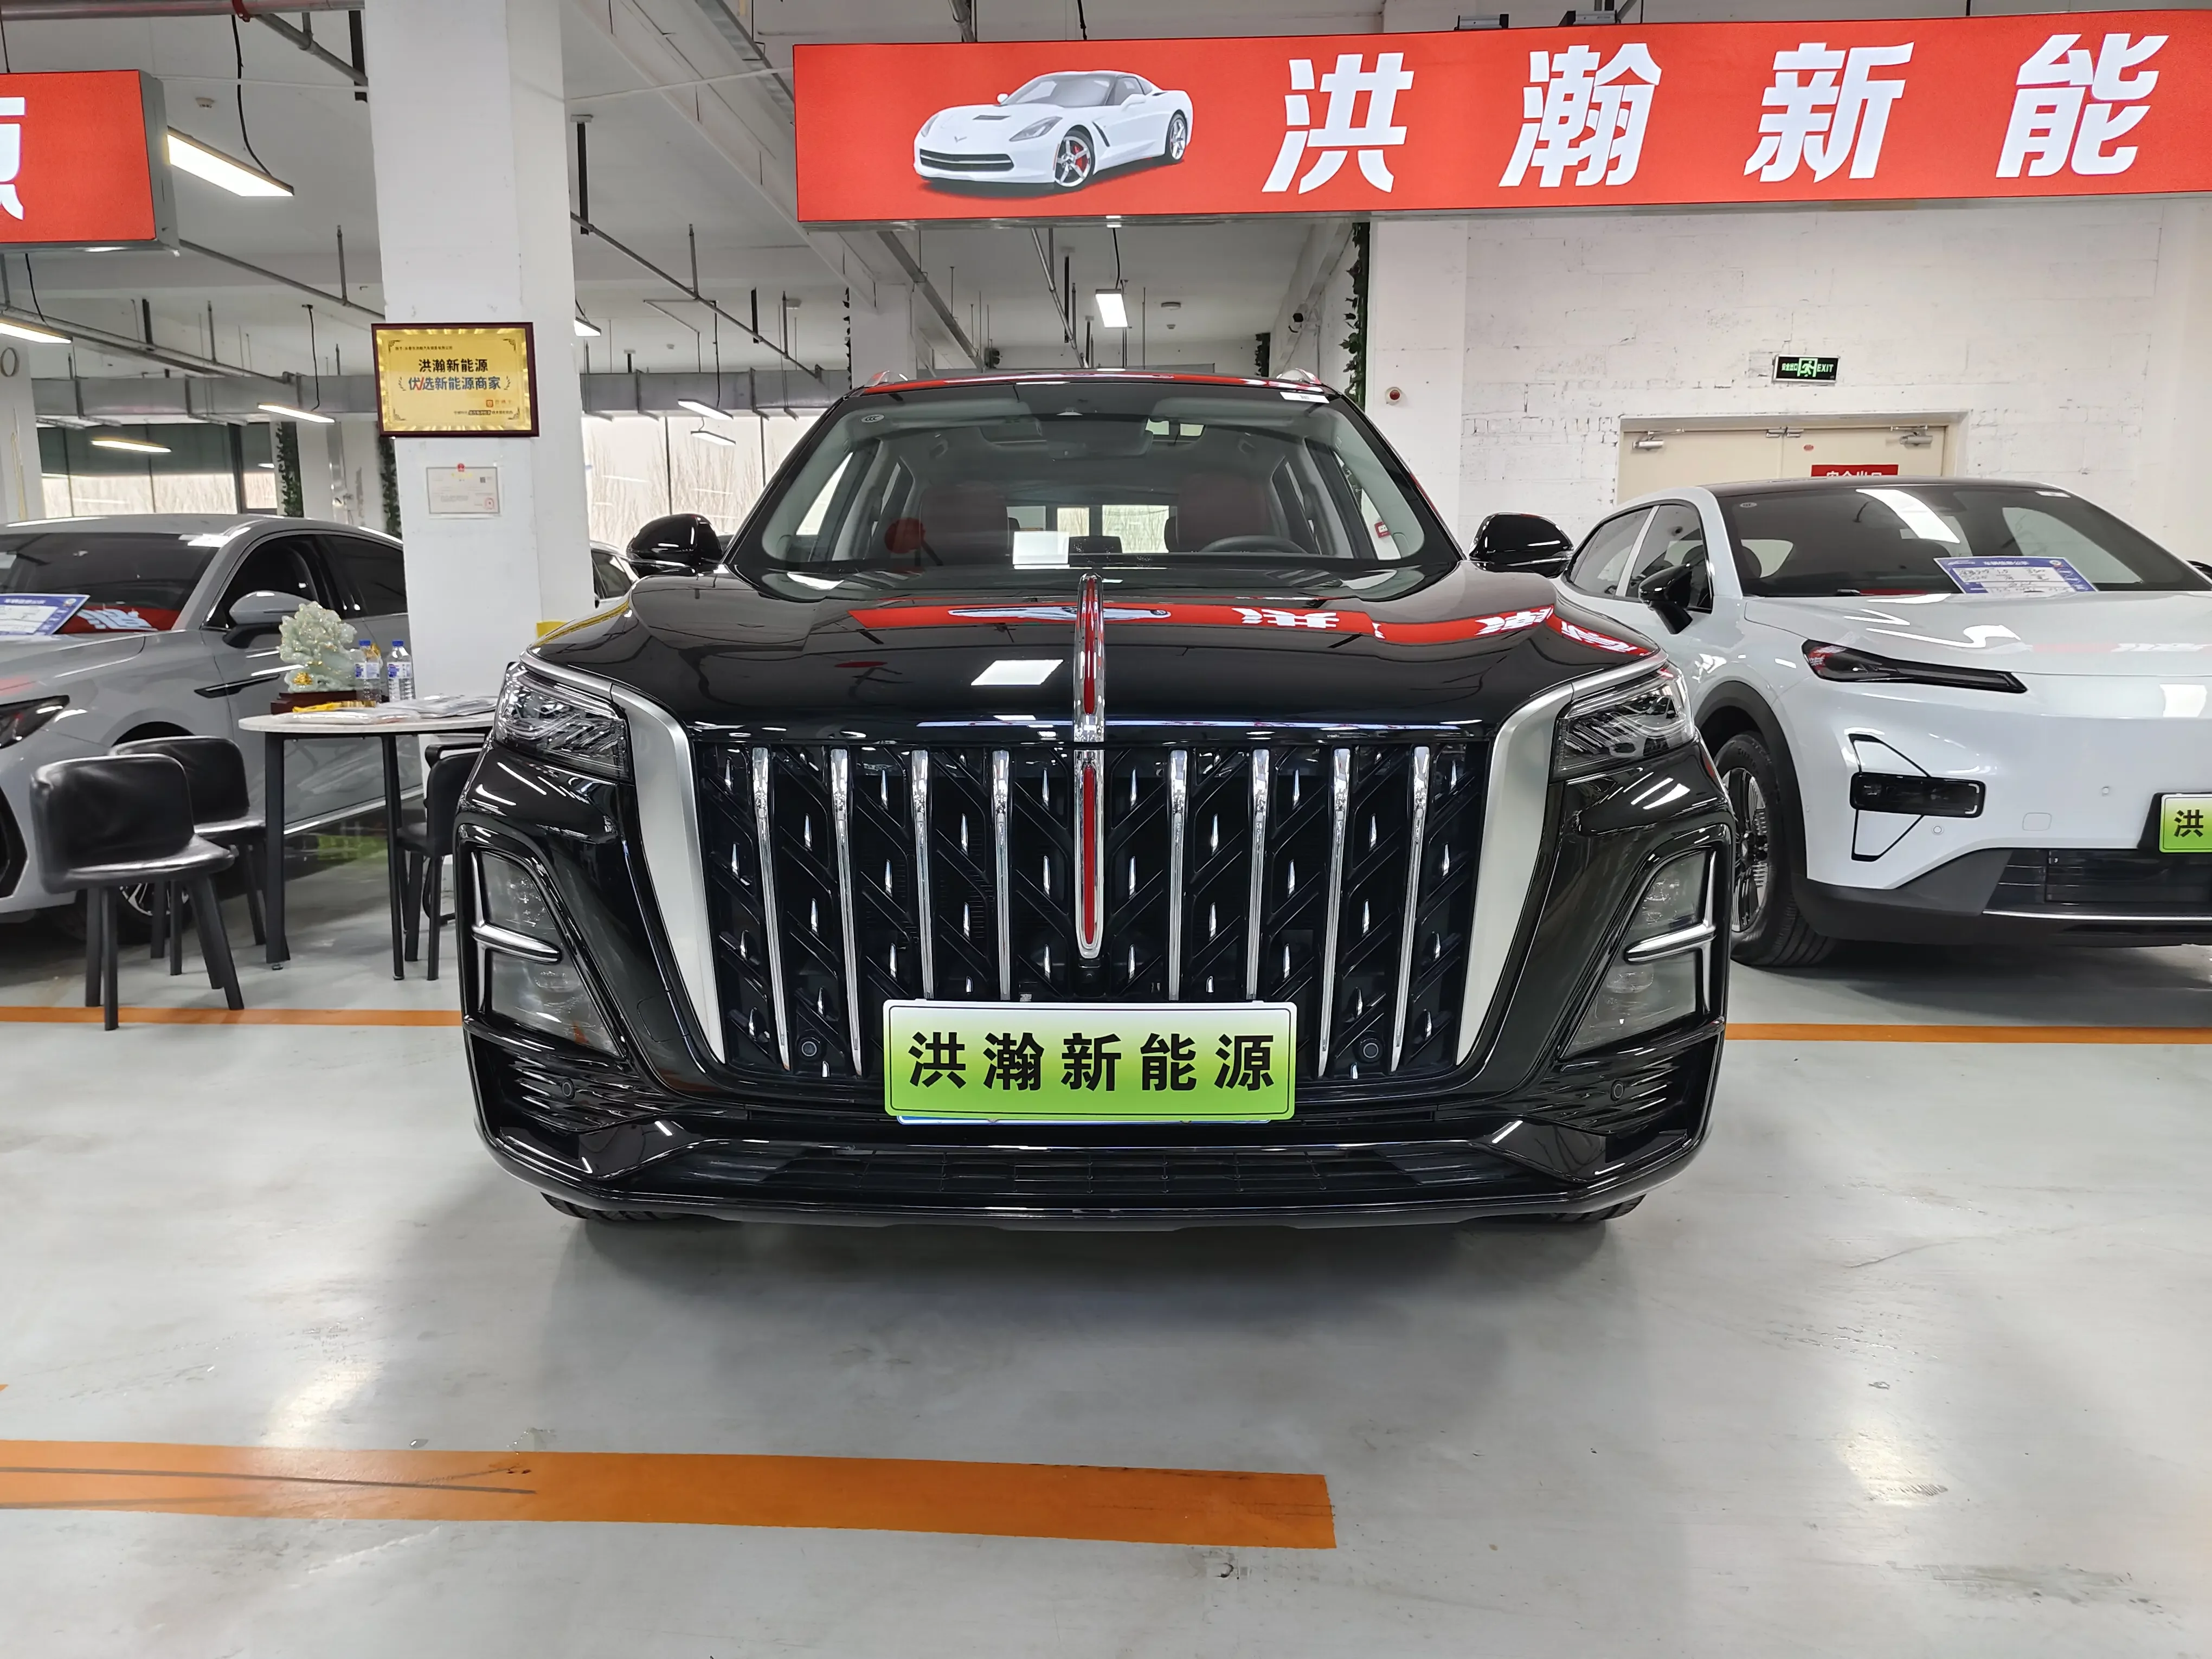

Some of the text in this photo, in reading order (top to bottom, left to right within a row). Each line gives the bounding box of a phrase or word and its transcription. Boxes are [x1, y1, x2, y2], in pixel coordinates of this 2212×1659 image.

[1262, 33, 2169, 194] 洪瀚新能
[418, 358, 488, 372] 洪瀚新能源
[1816, 364, 1834, 372] EXIT
[408, 376, 501, 390] 优选新能源商家
[2174, 809, 2204, 838] 洪
[908, 1031, 1275, 1092] 洪瀚新能源
